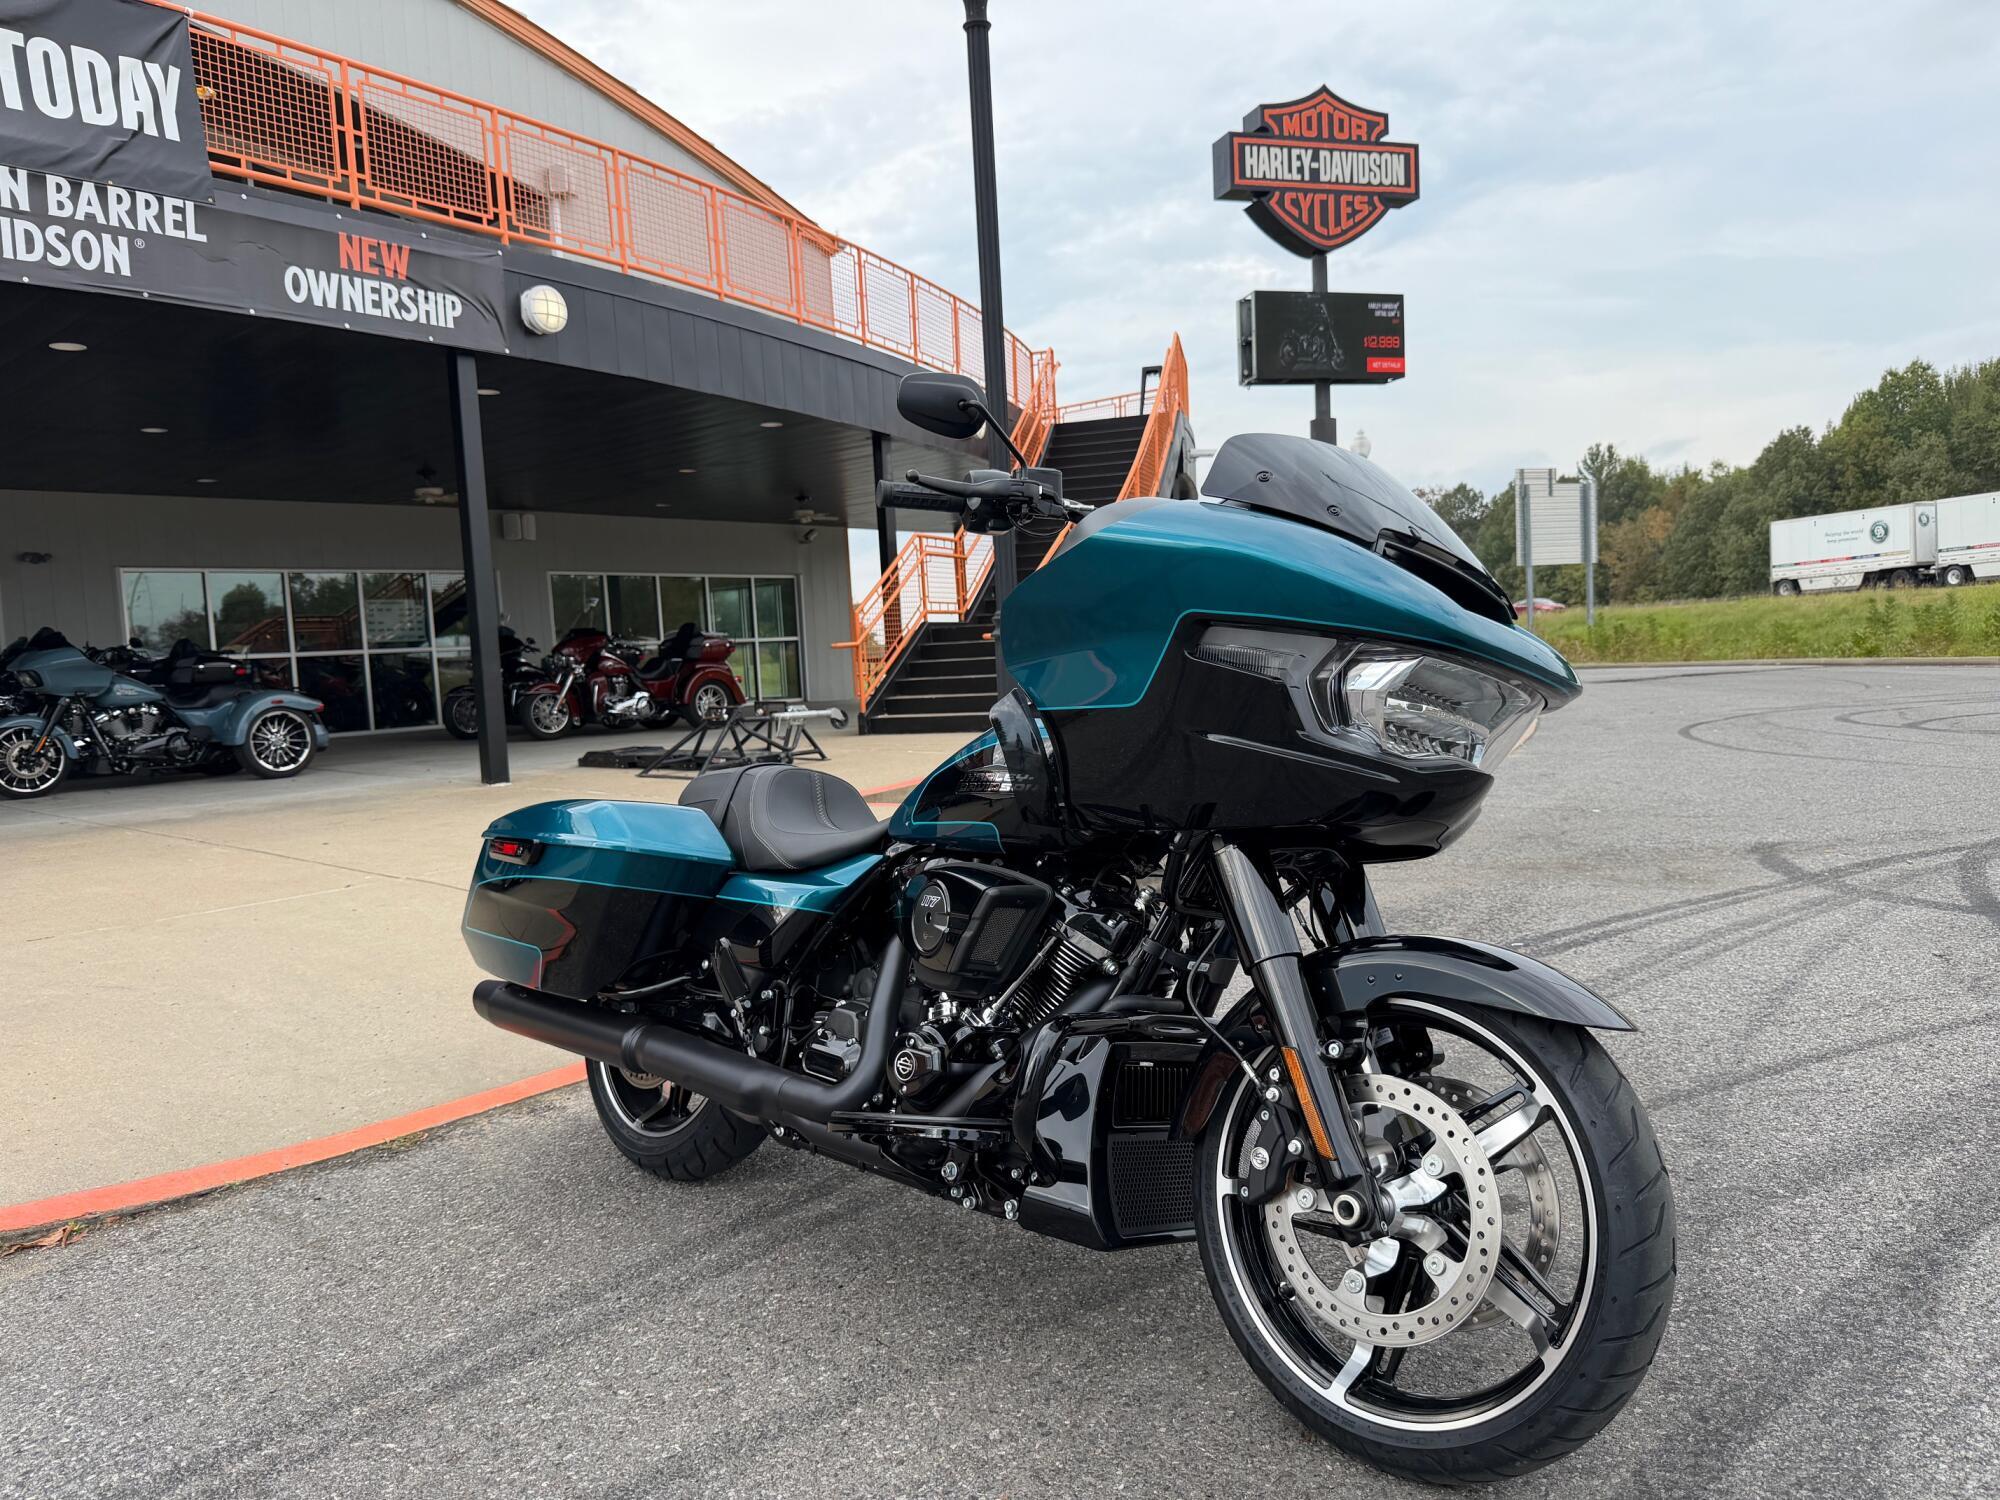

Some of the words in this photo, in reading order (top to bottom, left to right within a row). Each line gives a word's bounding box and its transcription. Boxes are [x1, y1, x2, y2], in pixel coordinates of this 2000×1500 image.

[0, 27, 181, 142] TODAY
[1282, 101, 1367, 141] MOTOR
[1244, 144, 1405, 186] HARLEY-DAVIDSON
[0, 164, 31, 212] N
[45, 173, 208, 243] BARREL
[1284, 191, 1372, 236] CYCLES
[338, 231, 411, 280] NEW
[284, 265, 463, 328] OWNERSHIP
[921, 895, 941, 908] 117
